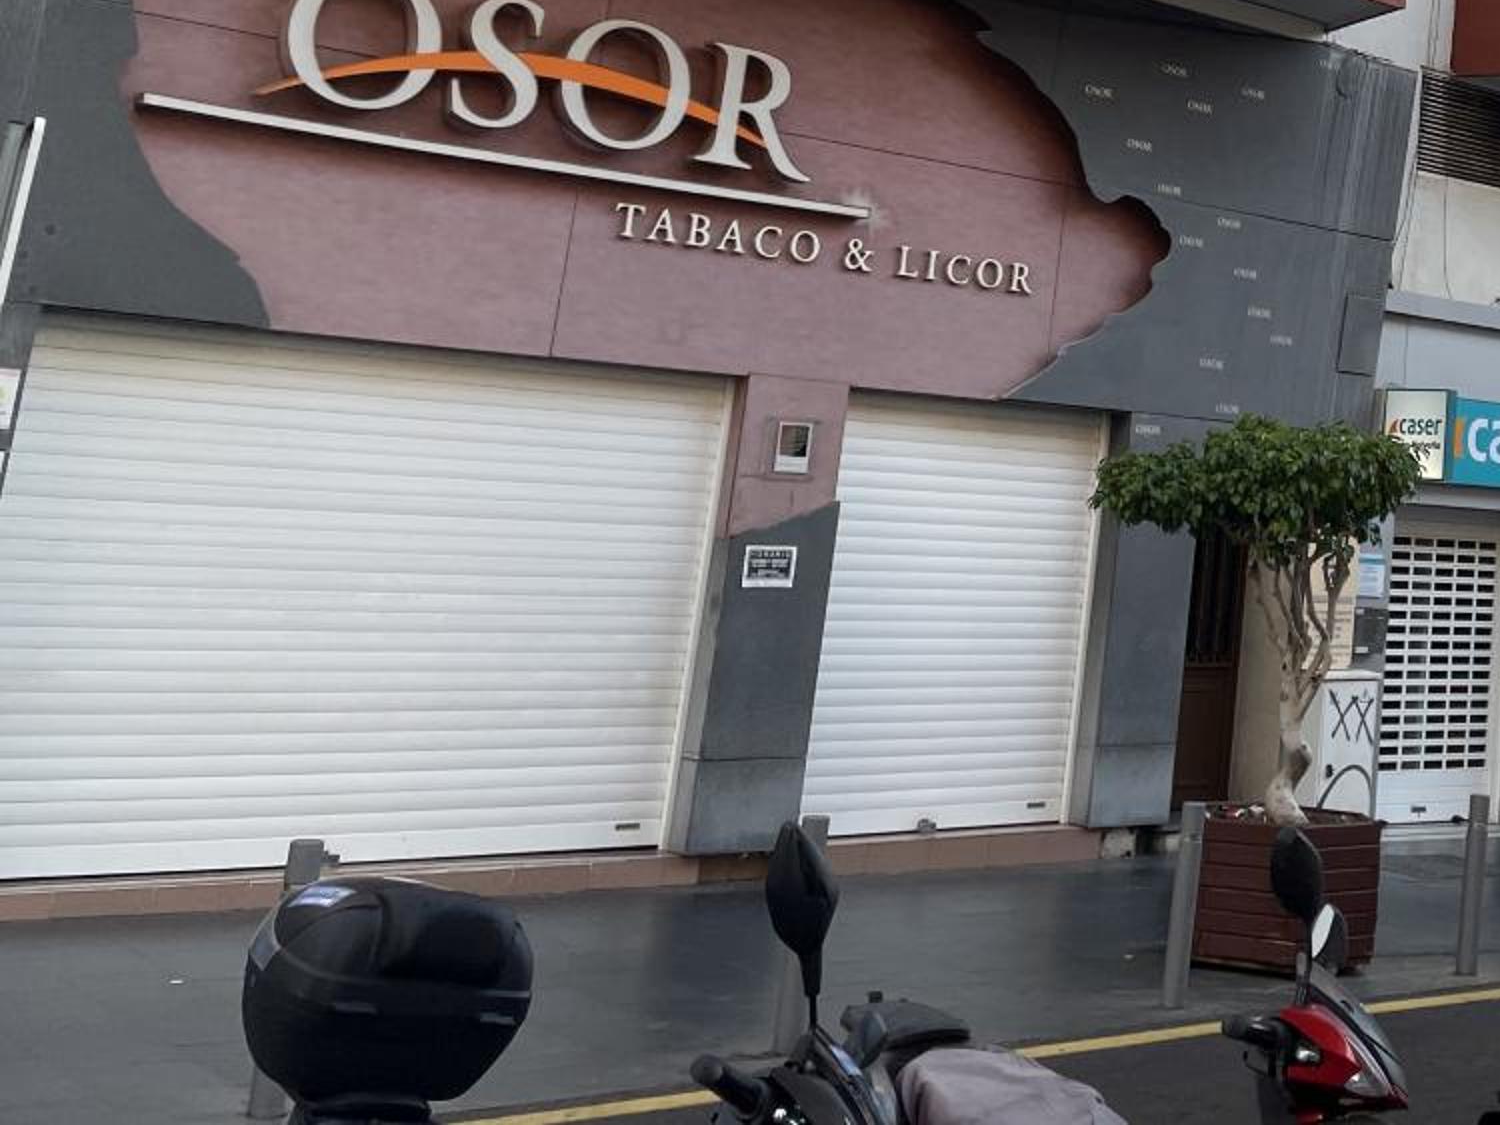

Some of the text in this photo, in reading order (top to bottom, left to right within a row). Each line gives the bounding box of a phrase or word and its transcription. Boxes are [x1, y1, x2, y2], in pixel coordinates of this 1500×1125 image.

[616, 203, 1033, 294] TABACO & LICOR
[1400, 418, 1443, 436] caser
